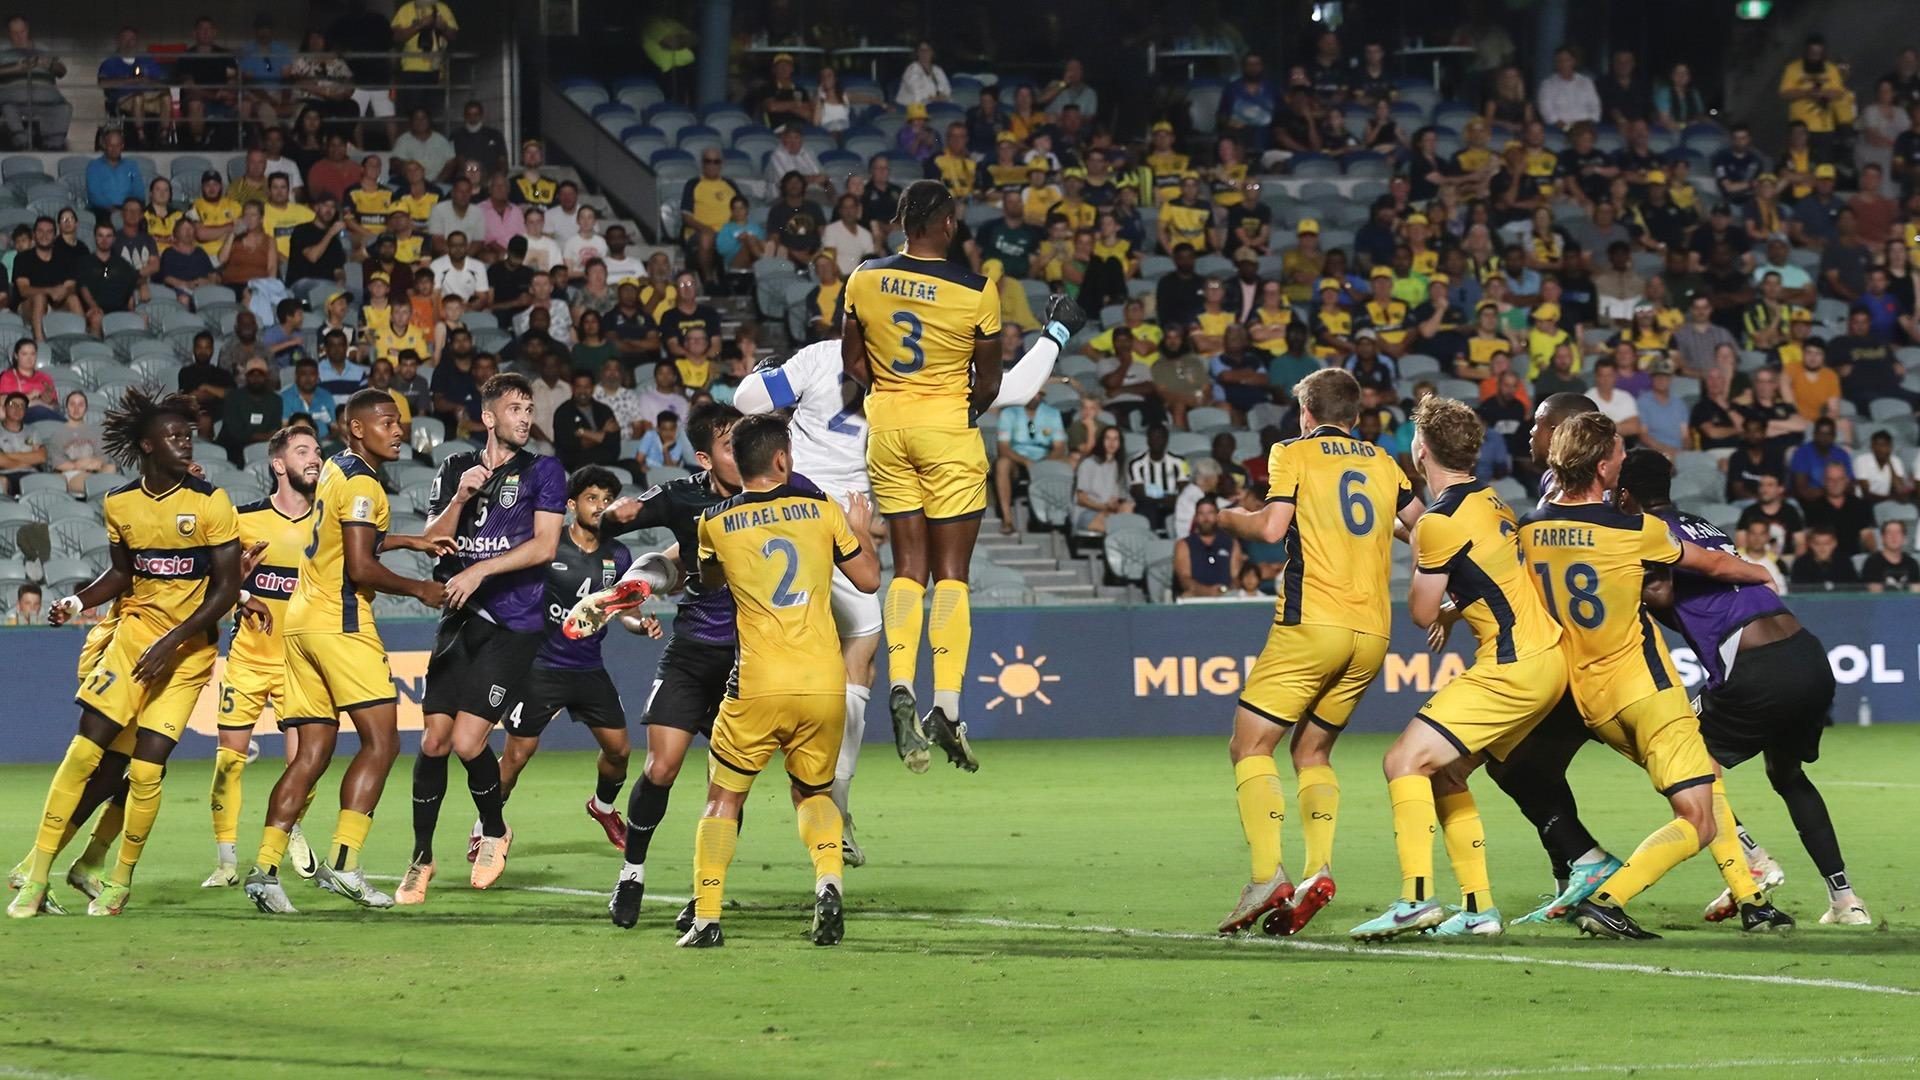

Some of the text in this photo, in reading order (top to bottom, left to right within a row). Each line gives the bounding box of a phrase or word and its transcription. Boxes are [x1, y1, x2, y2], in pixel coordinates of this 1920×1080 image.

[881, 276, 938, 301] KALTAK
[891, 311, 925, 374] 3
[1321, 441, 1376, 457] BALARD
[474, 496, 489, 527] 5
[1339, 470, 1374, 535] 6
[723, 503, 821, 533] MIKAEL DOKA
[457, 536, 511, 552] ODISHA
[1533, 529, 1595, 547] FARRELL
[762, 537, 808, 607] 2
[576, 577, 592, 598] 4
[1534, 562, 1605, 629] 18
[509, 702, 524, 728] 4
